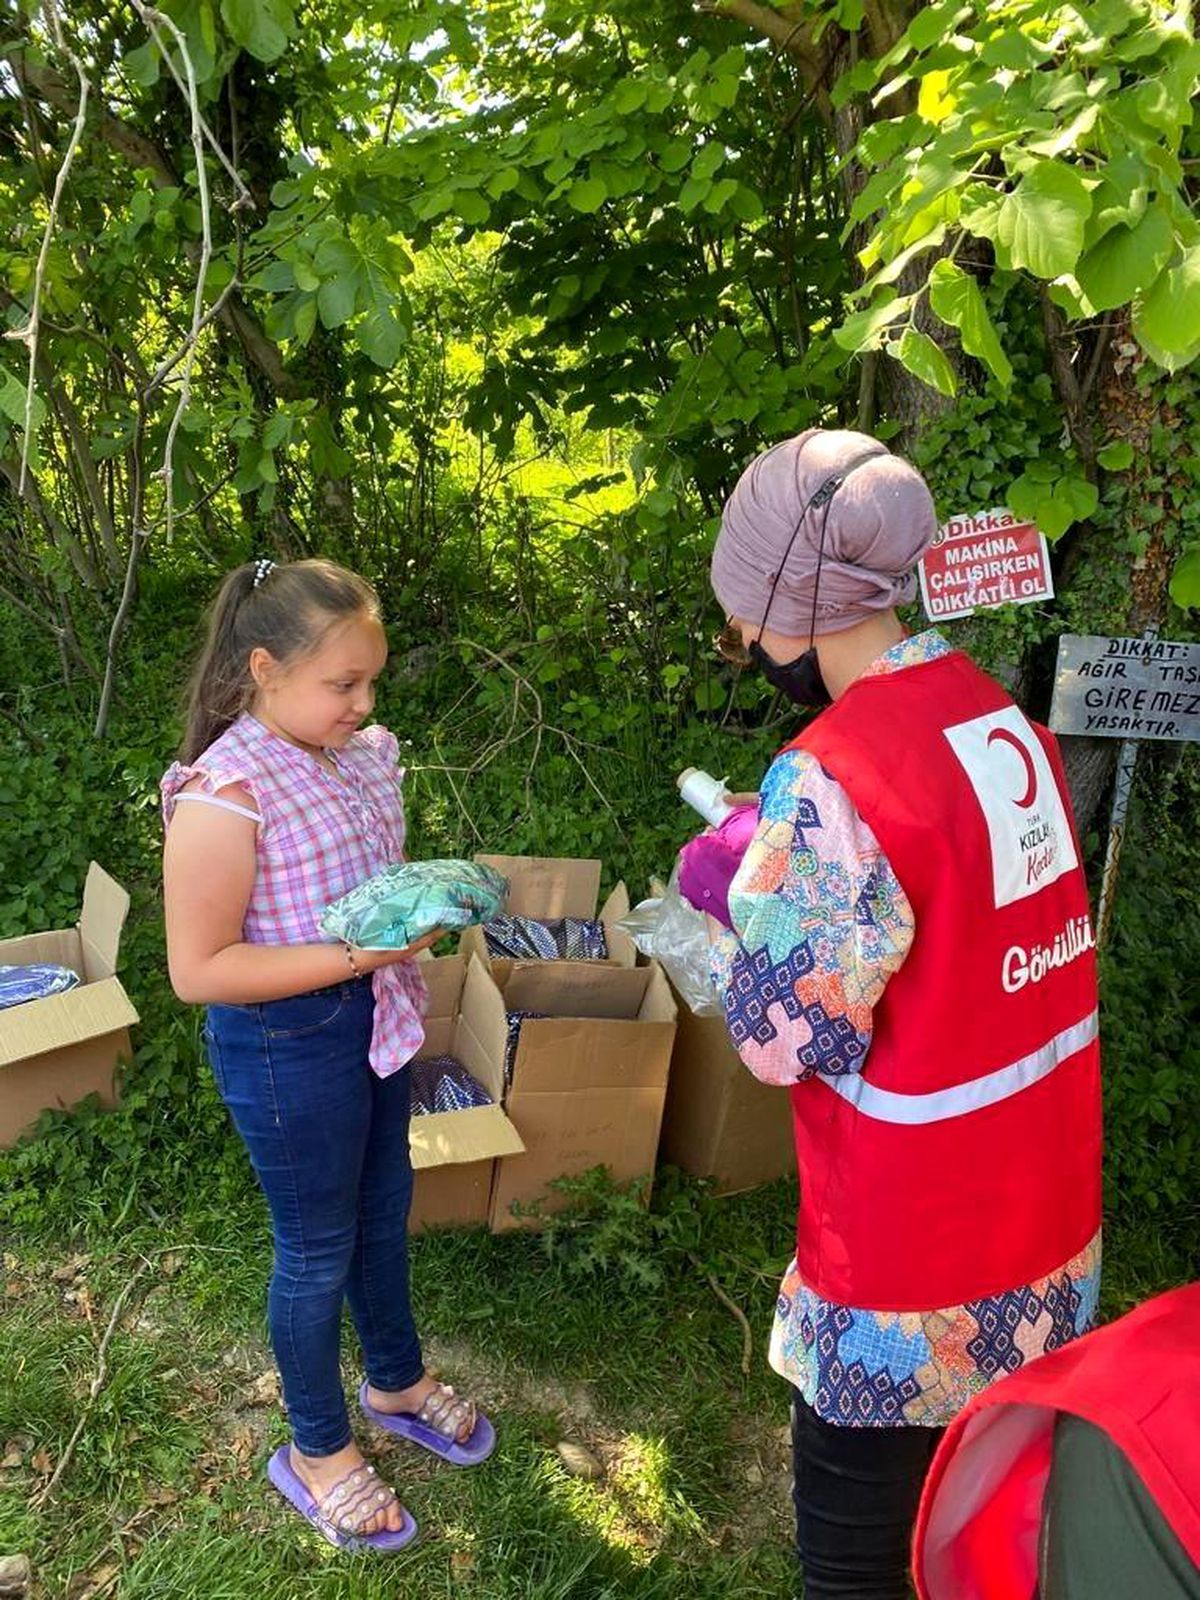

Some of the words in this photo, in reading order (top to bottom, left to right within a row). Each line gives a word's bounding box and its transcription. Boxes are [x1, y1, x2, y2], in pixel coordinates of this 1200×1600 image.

[948, 514, 1015, 537] Dikka
[945, 537, 1019, 566] MAKİNA
[930, 552, 1040, 593] ÇALIŞIRKEN
[931, 578, 1017, 614] DİKKATLİ
[1021, 577, 1046, 595] OL
[1078, 658, 1127, 679] AĞIR
[1159, 666, 1200, 684] TAŞ
[1085, 714, 1180, 737] YASAKTIR.
[1002, 914, 1096, 994] Gönüllü
